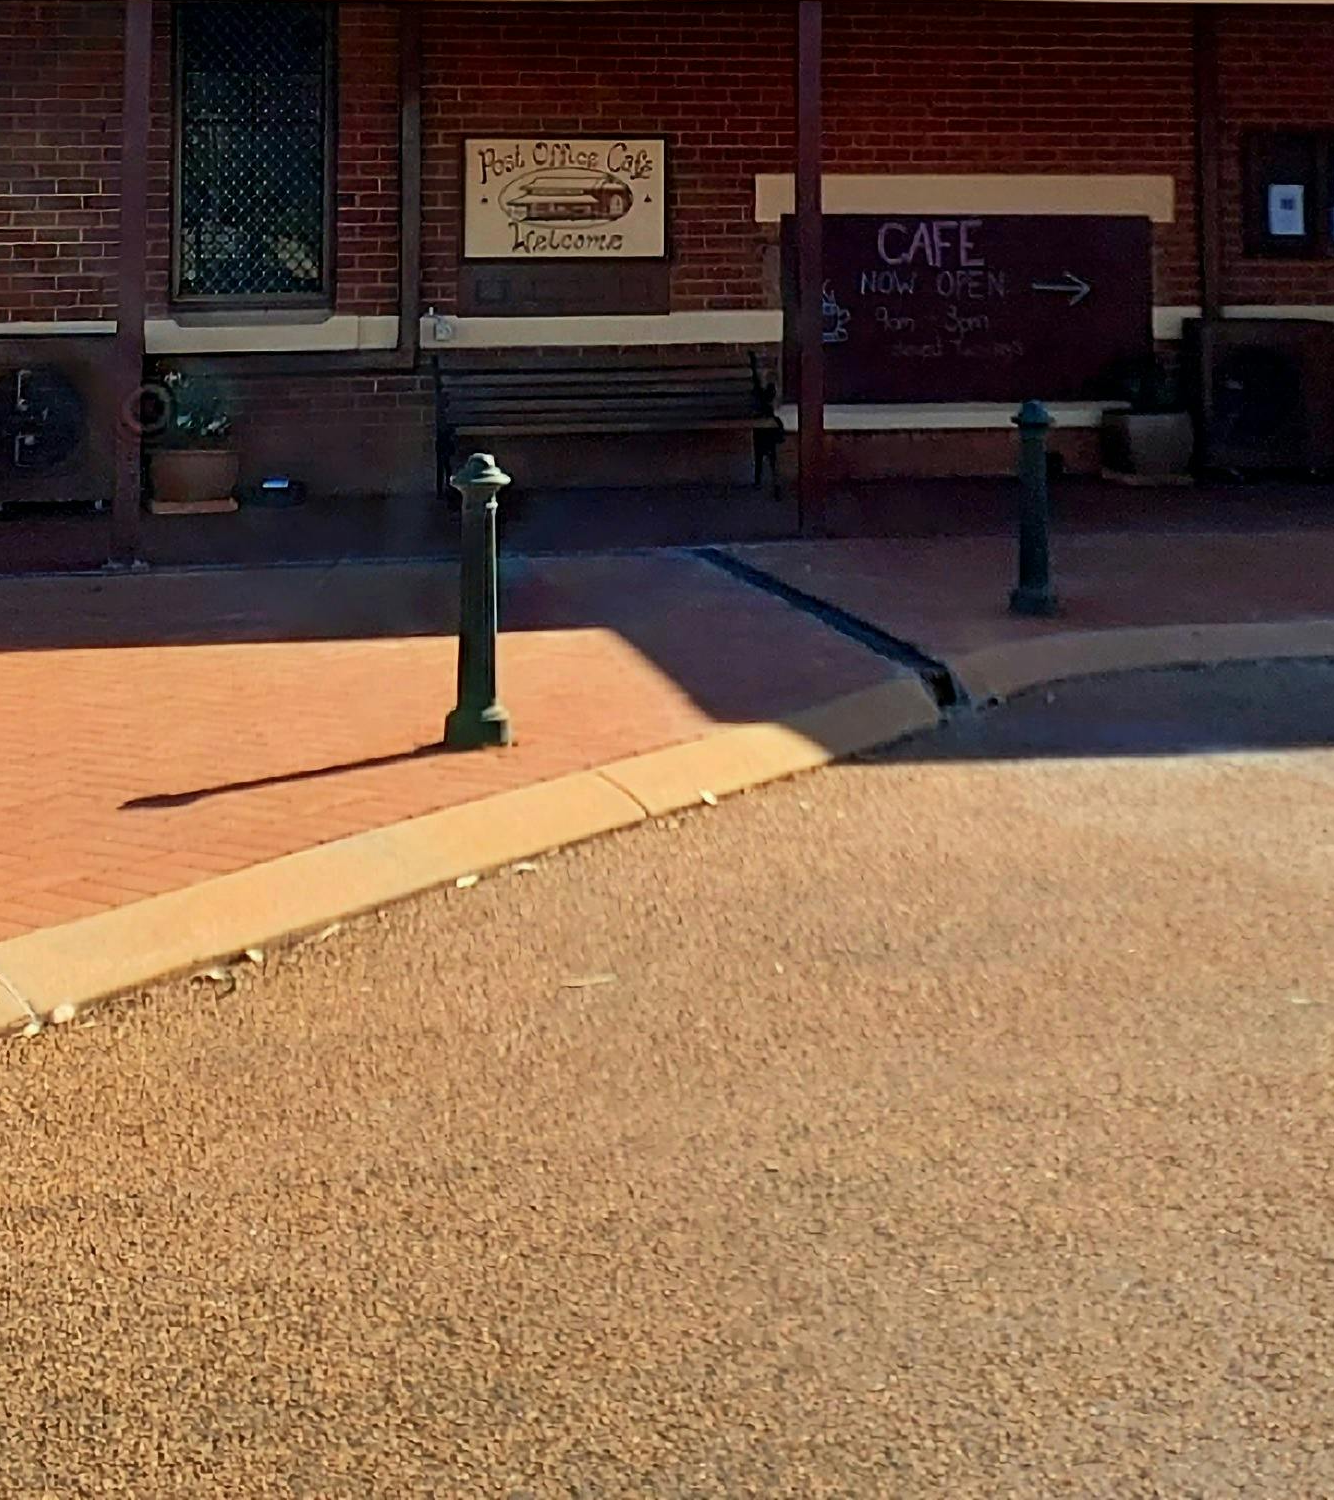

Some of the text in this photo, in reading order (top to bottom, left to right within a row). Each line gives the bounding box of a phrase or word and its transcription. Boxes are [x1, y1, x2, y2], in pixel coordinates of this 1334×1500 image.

[478, 144, 525, 184] Post
[532, 142, 599, 168] Office
[508, 221, 624, 253] Welcome
[877, 219, 985, 268] CAFE
[860, 270, 1007, 300] NOW OPEN
